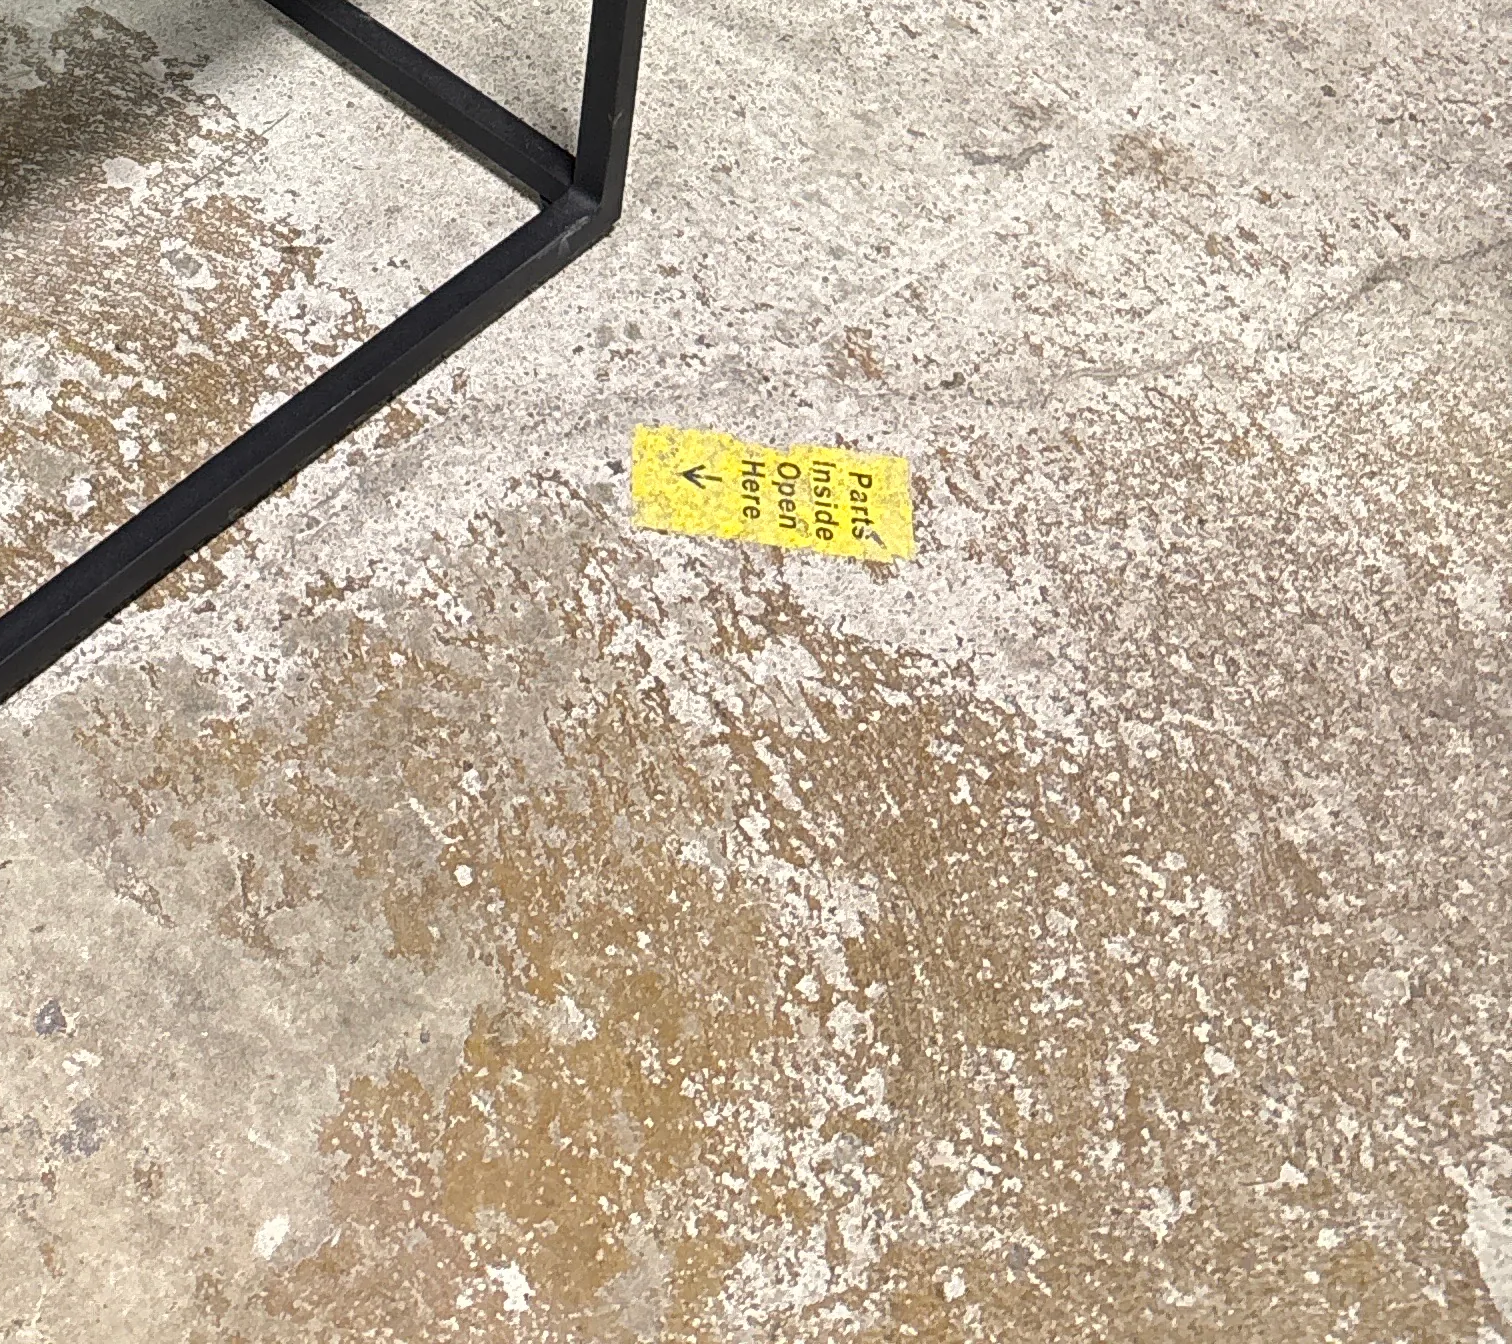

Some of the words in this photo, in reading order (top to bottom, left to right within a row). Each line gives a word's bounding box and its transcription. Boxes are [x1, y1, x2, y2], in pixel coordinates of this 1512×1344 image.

[741, 459, 766, 520] Here
[771, 461, 801, 530] Open
[809, 460, 839, 542] Inside
[848, 471, 875, 540] Parts
